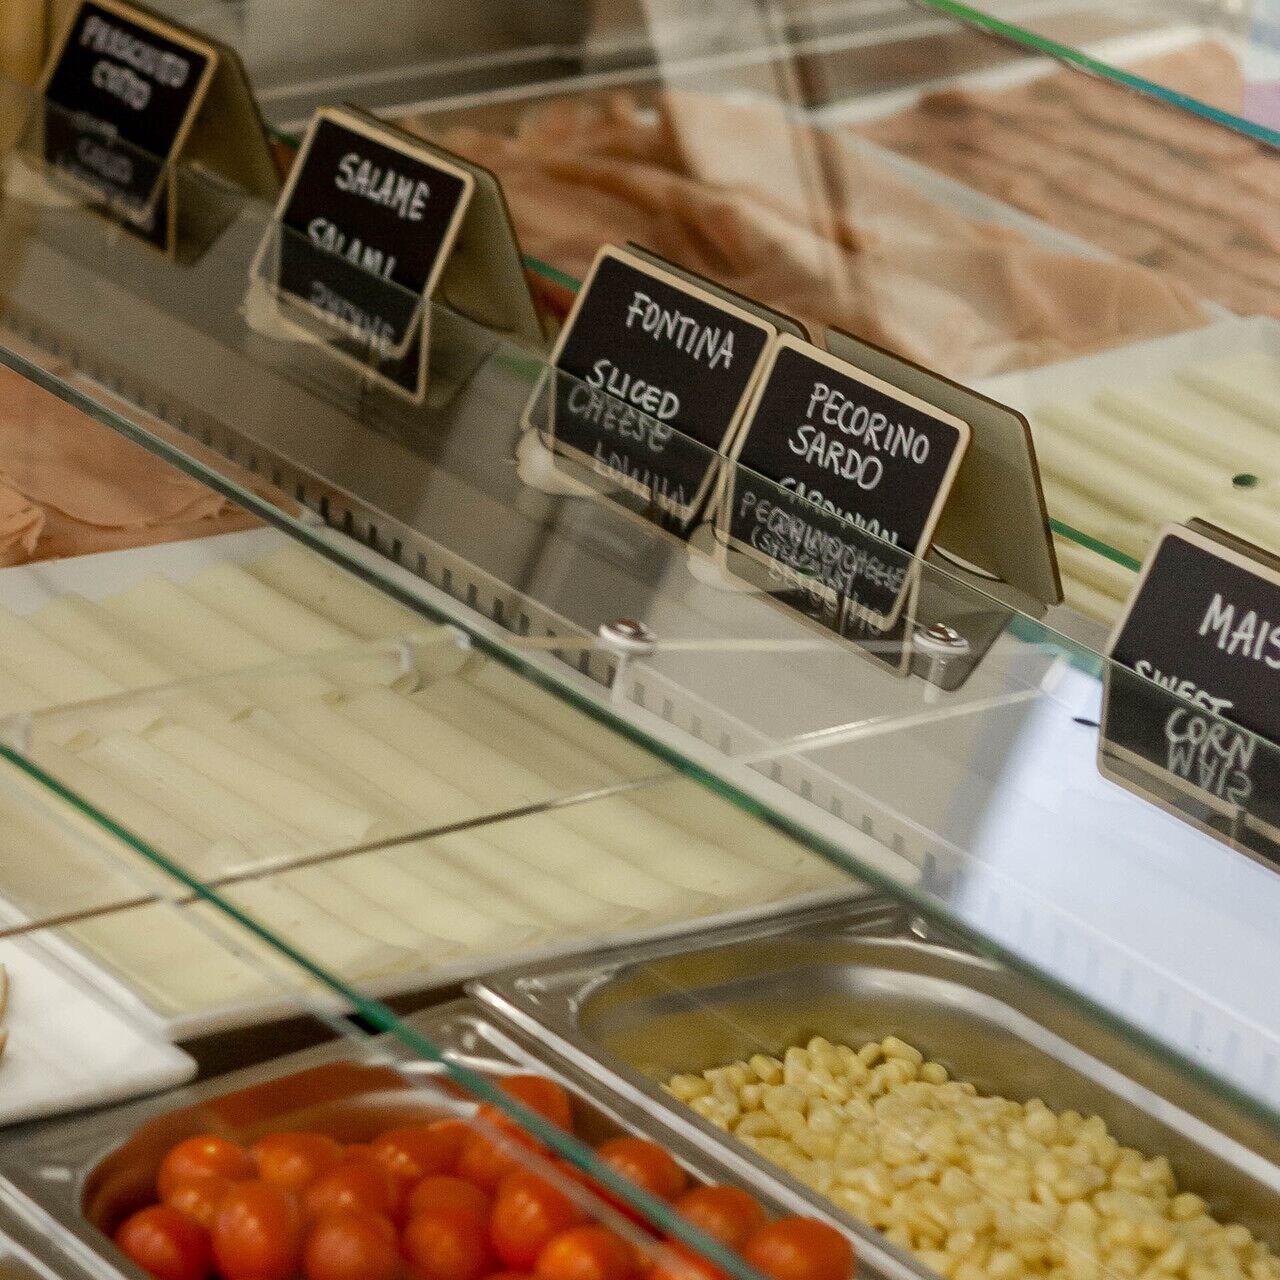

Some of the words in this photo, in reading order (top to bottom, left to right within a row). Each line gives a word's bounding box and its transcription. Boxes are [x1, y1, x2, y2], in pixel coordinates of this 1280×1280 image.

[334, 152, 431, 220] SALAME
[625, 291, 734, 369] FONTINA
[586, 358, 680, 419] SLICED
[806, 382, 930, 464] PECORINO
[788, 425, 883, 490] SARDO
[1198, 593, 1280, 669] MAIS
[1165, 707, 1256, 770] CORN
